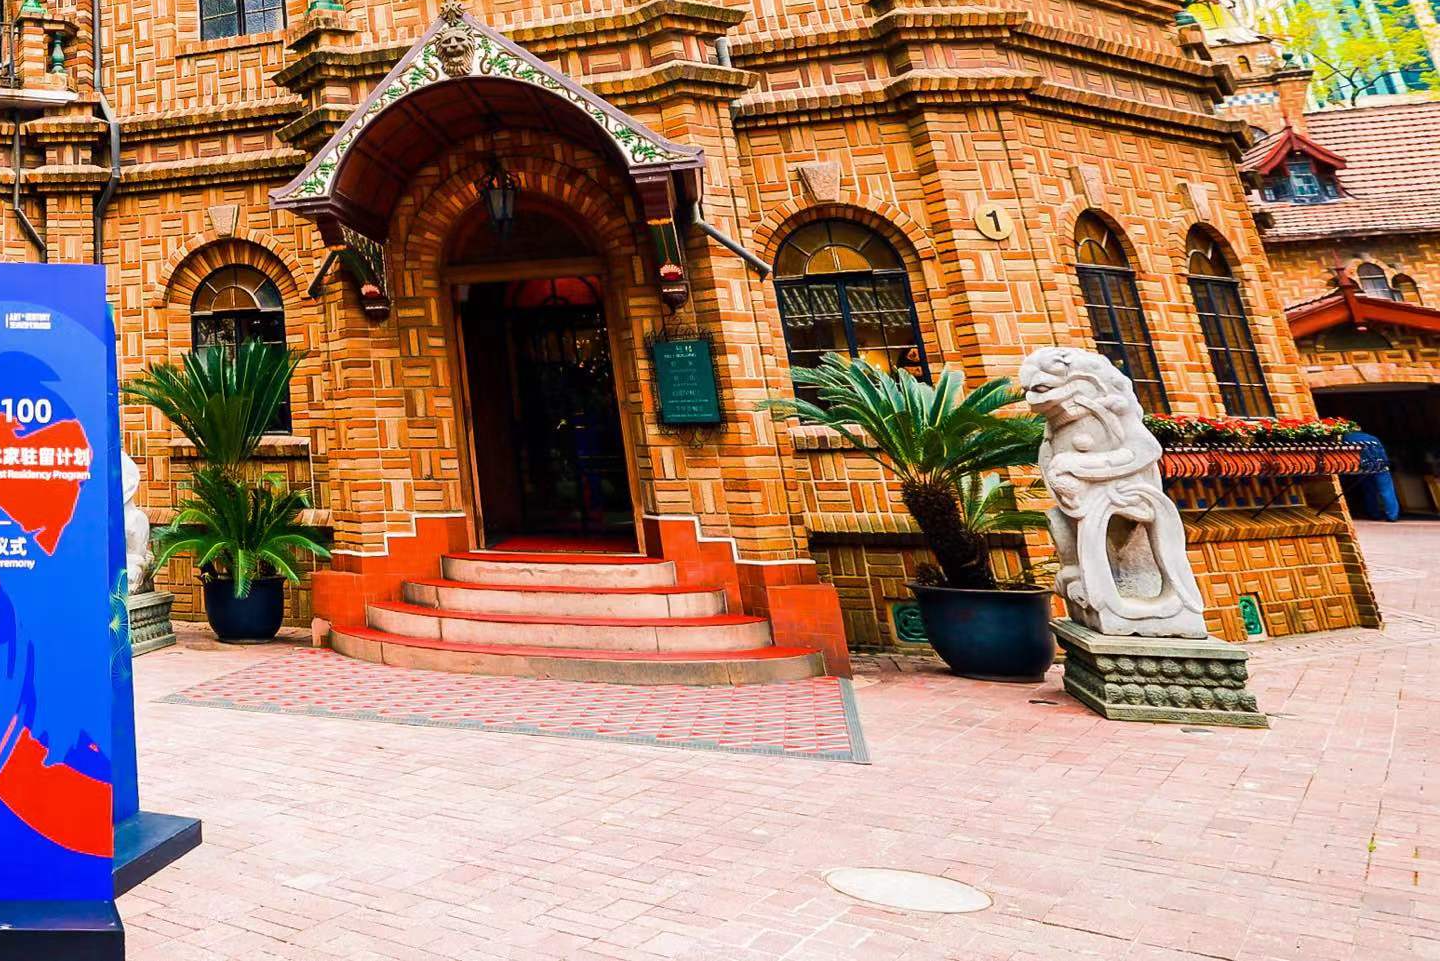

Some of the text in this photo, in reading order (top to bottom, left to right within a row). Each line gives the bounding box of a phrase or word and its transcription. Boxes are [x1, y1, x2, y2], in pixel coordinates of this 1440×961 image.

[986, 210, 1001, 232] 1
[8, 470, 51, 480] Residency
[53, 470, 91, 480] Program
